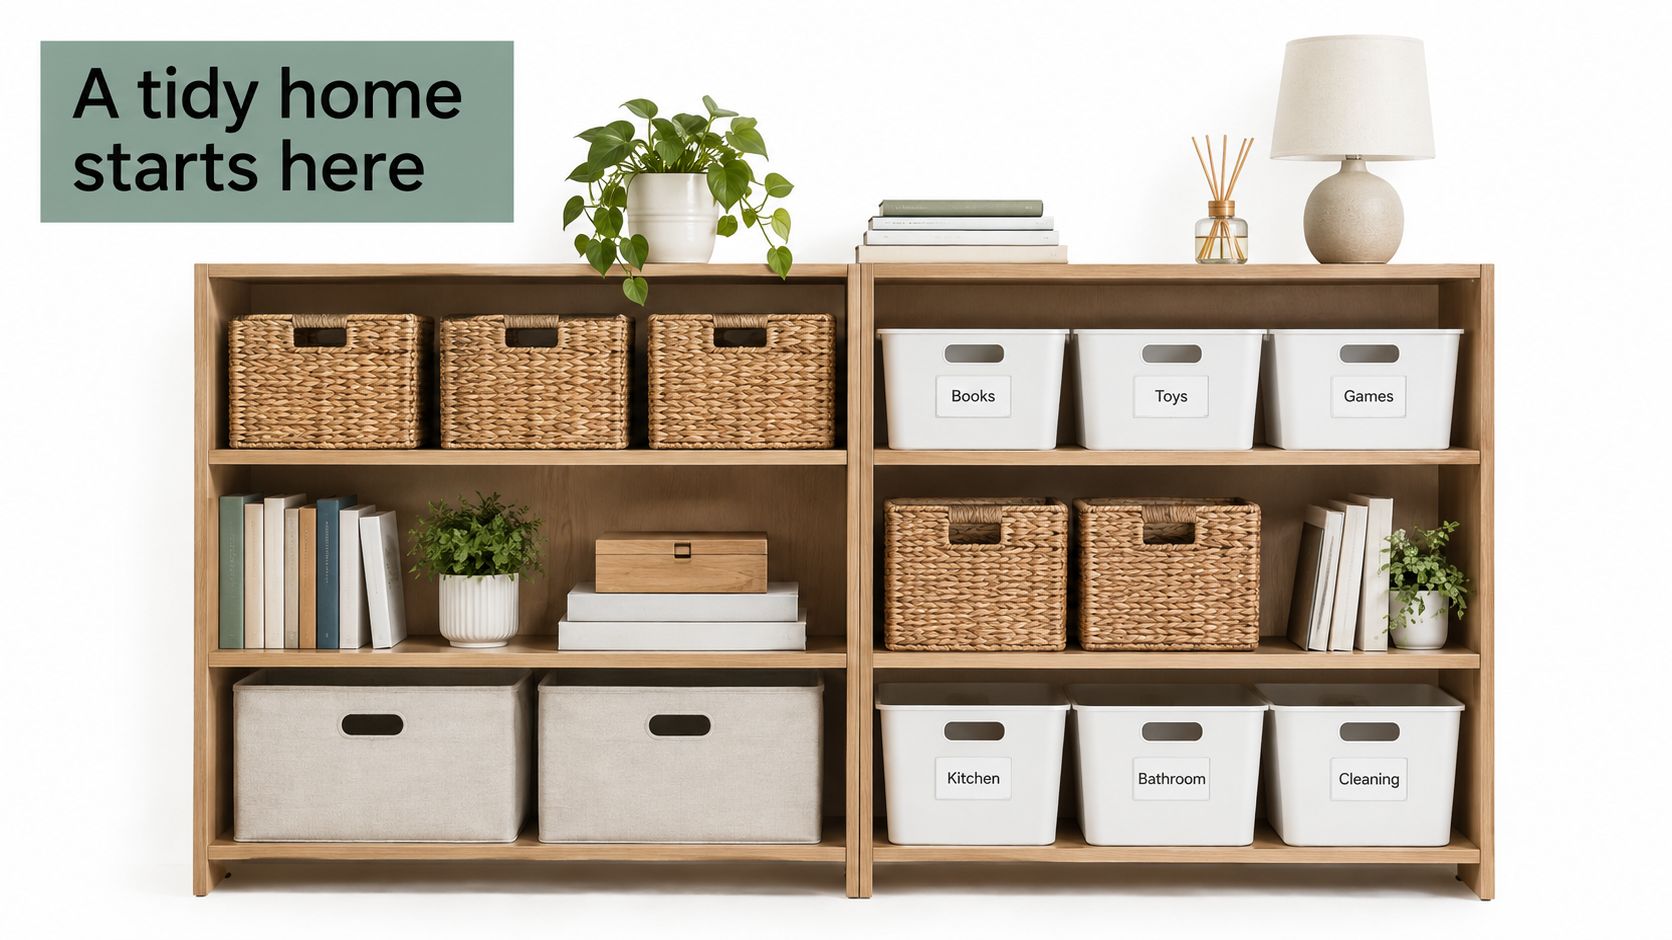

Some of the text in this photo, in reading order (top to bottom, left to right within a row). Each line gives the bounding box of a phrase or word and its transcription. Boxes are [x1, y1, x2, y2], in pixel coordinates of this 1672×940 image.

[951, 389, 996, 403] Books
[1154, 389, 1188, 406] Toys
[1343, 389, 1394, 403] Games
[947, 771, 1000, 785] Kitchen
[1138, 772, 1206, 785] Bathroom
[1339, 772, 1400, 789] Cleaning
